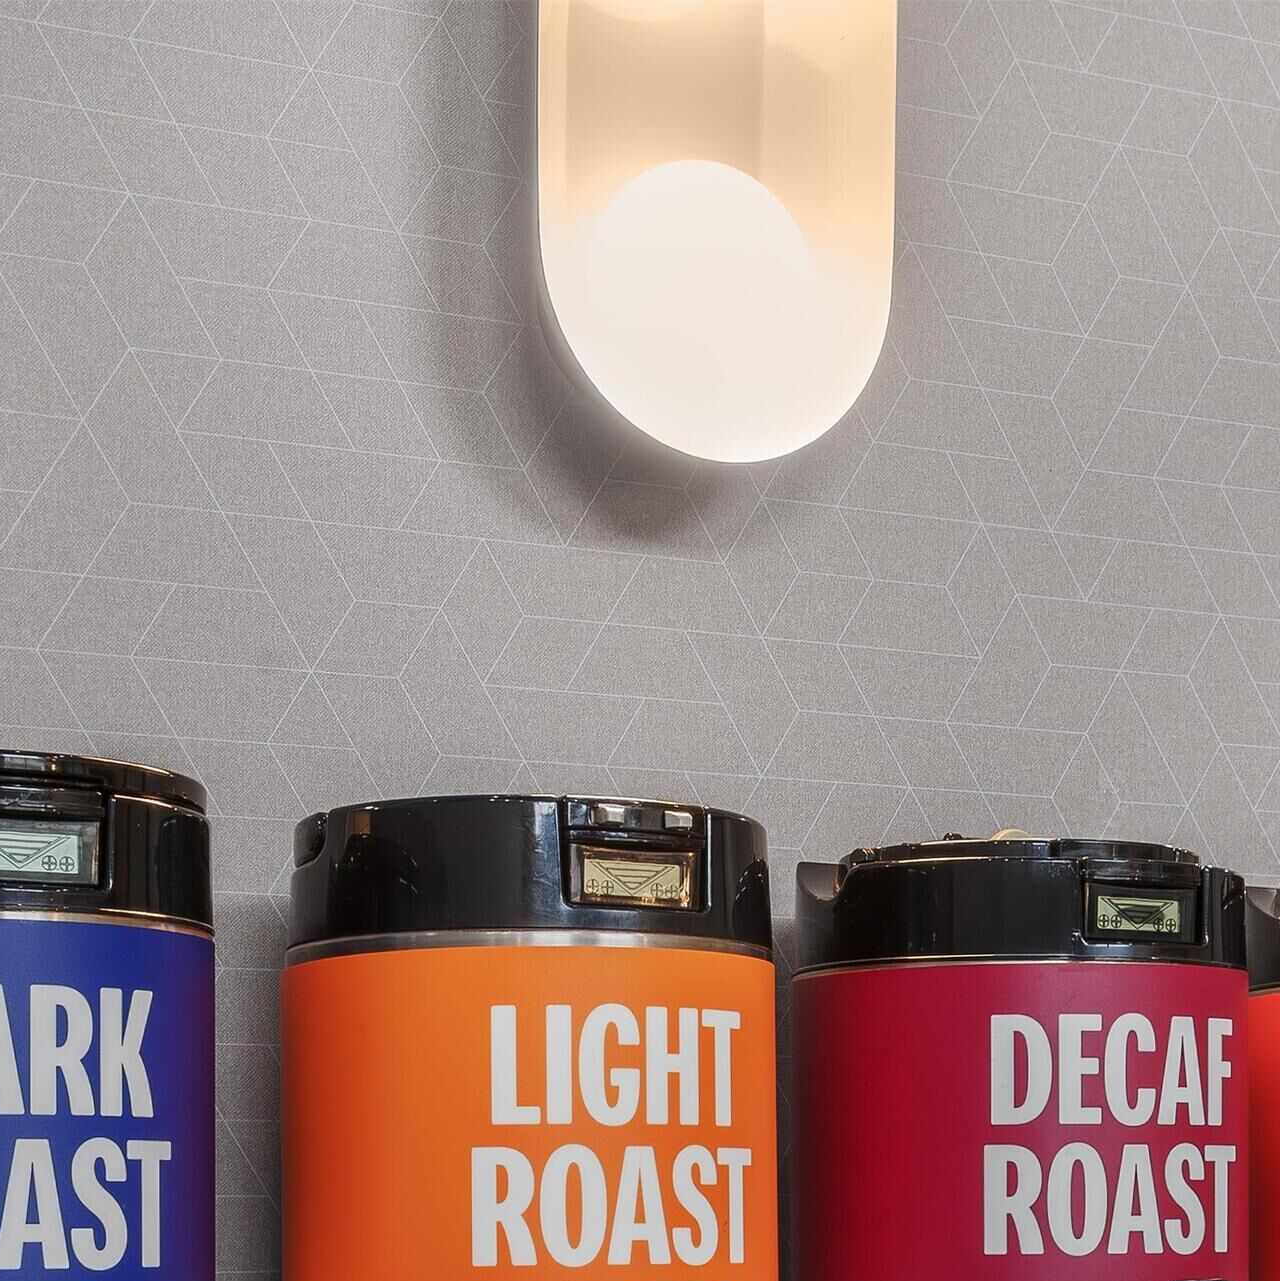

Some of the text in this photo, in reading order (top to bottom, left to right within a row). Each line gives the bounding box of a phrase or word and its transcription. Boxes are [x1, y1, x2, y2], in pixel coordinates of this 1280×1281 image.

[490, 1003, 742, 1128] LIGHT
[990, 1012, 1234, 1128] DECAF
[471, 1144, 753, 1269] ROAST
[982, 1143, 1237, 1257] ROAST
